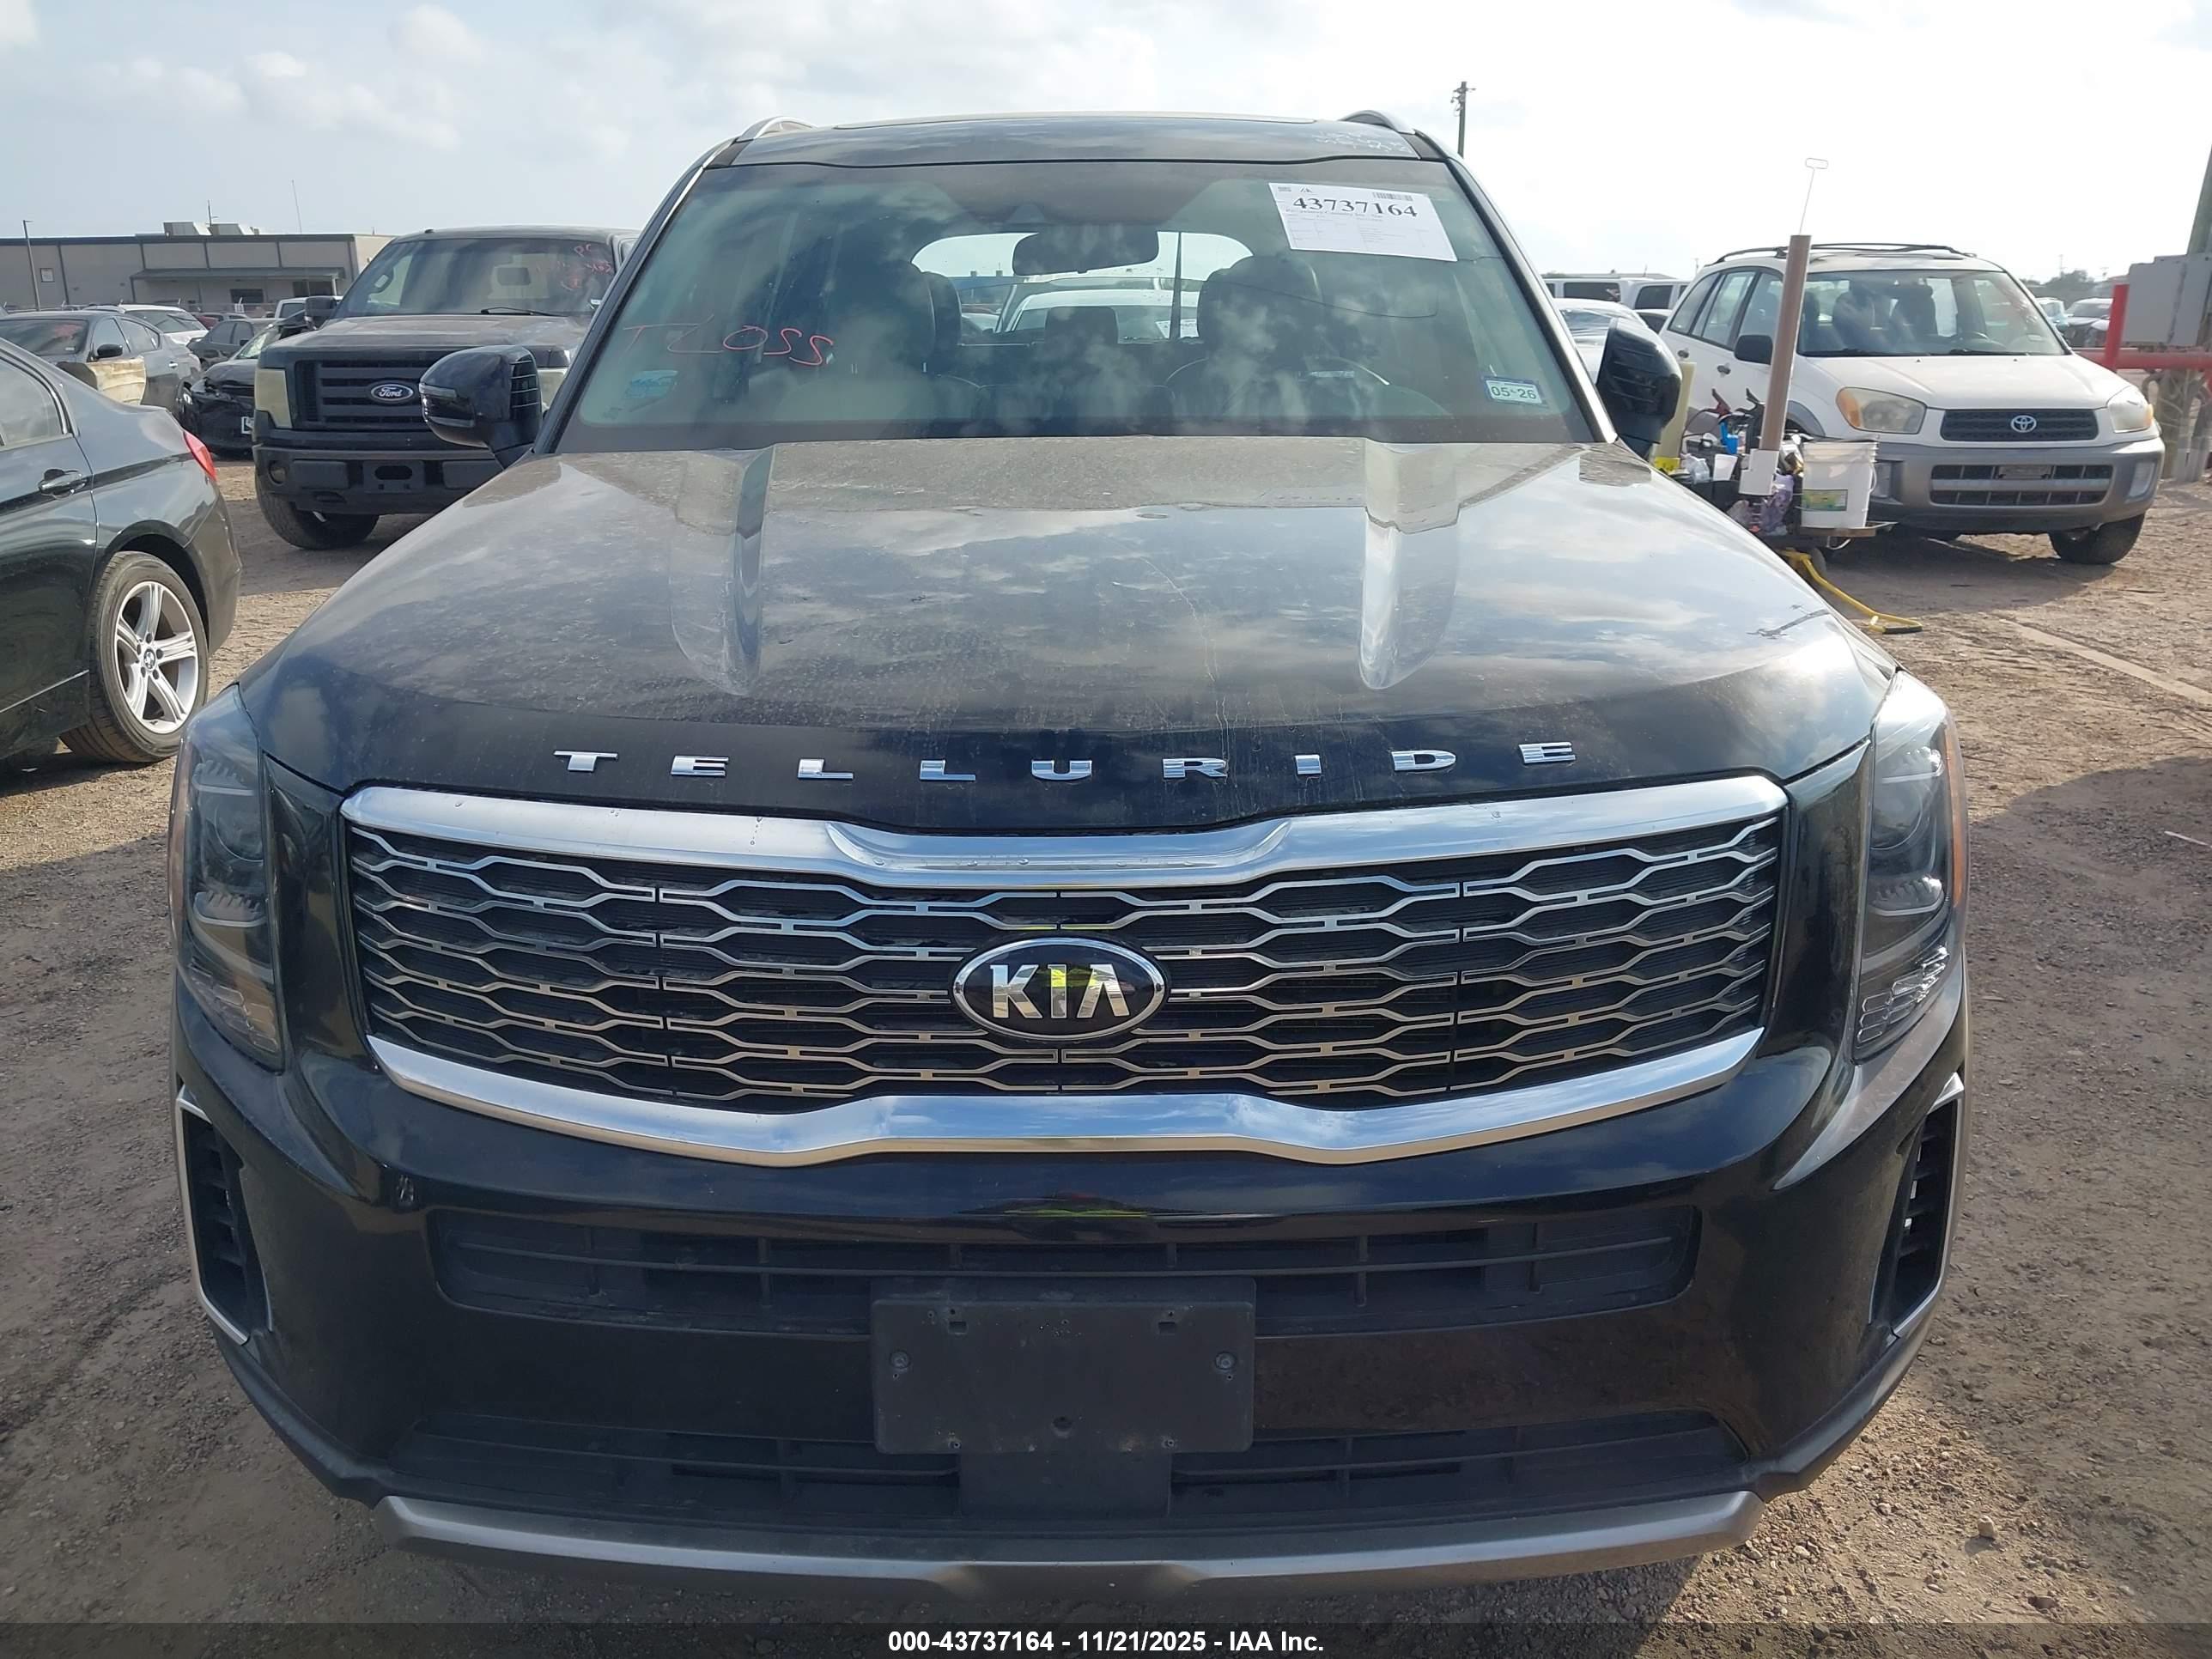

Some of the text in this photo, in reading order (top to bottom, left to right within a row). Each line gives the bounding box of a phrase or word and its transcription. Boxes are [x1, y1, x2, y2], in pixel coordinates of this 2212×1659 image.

[1292, 197, 1419, 217] 43737164
[379, 386, 403, 398] Ford
[553, 741, 1577, 782] TELLURIDE
[989, 963, 1131, 1019] KIA
